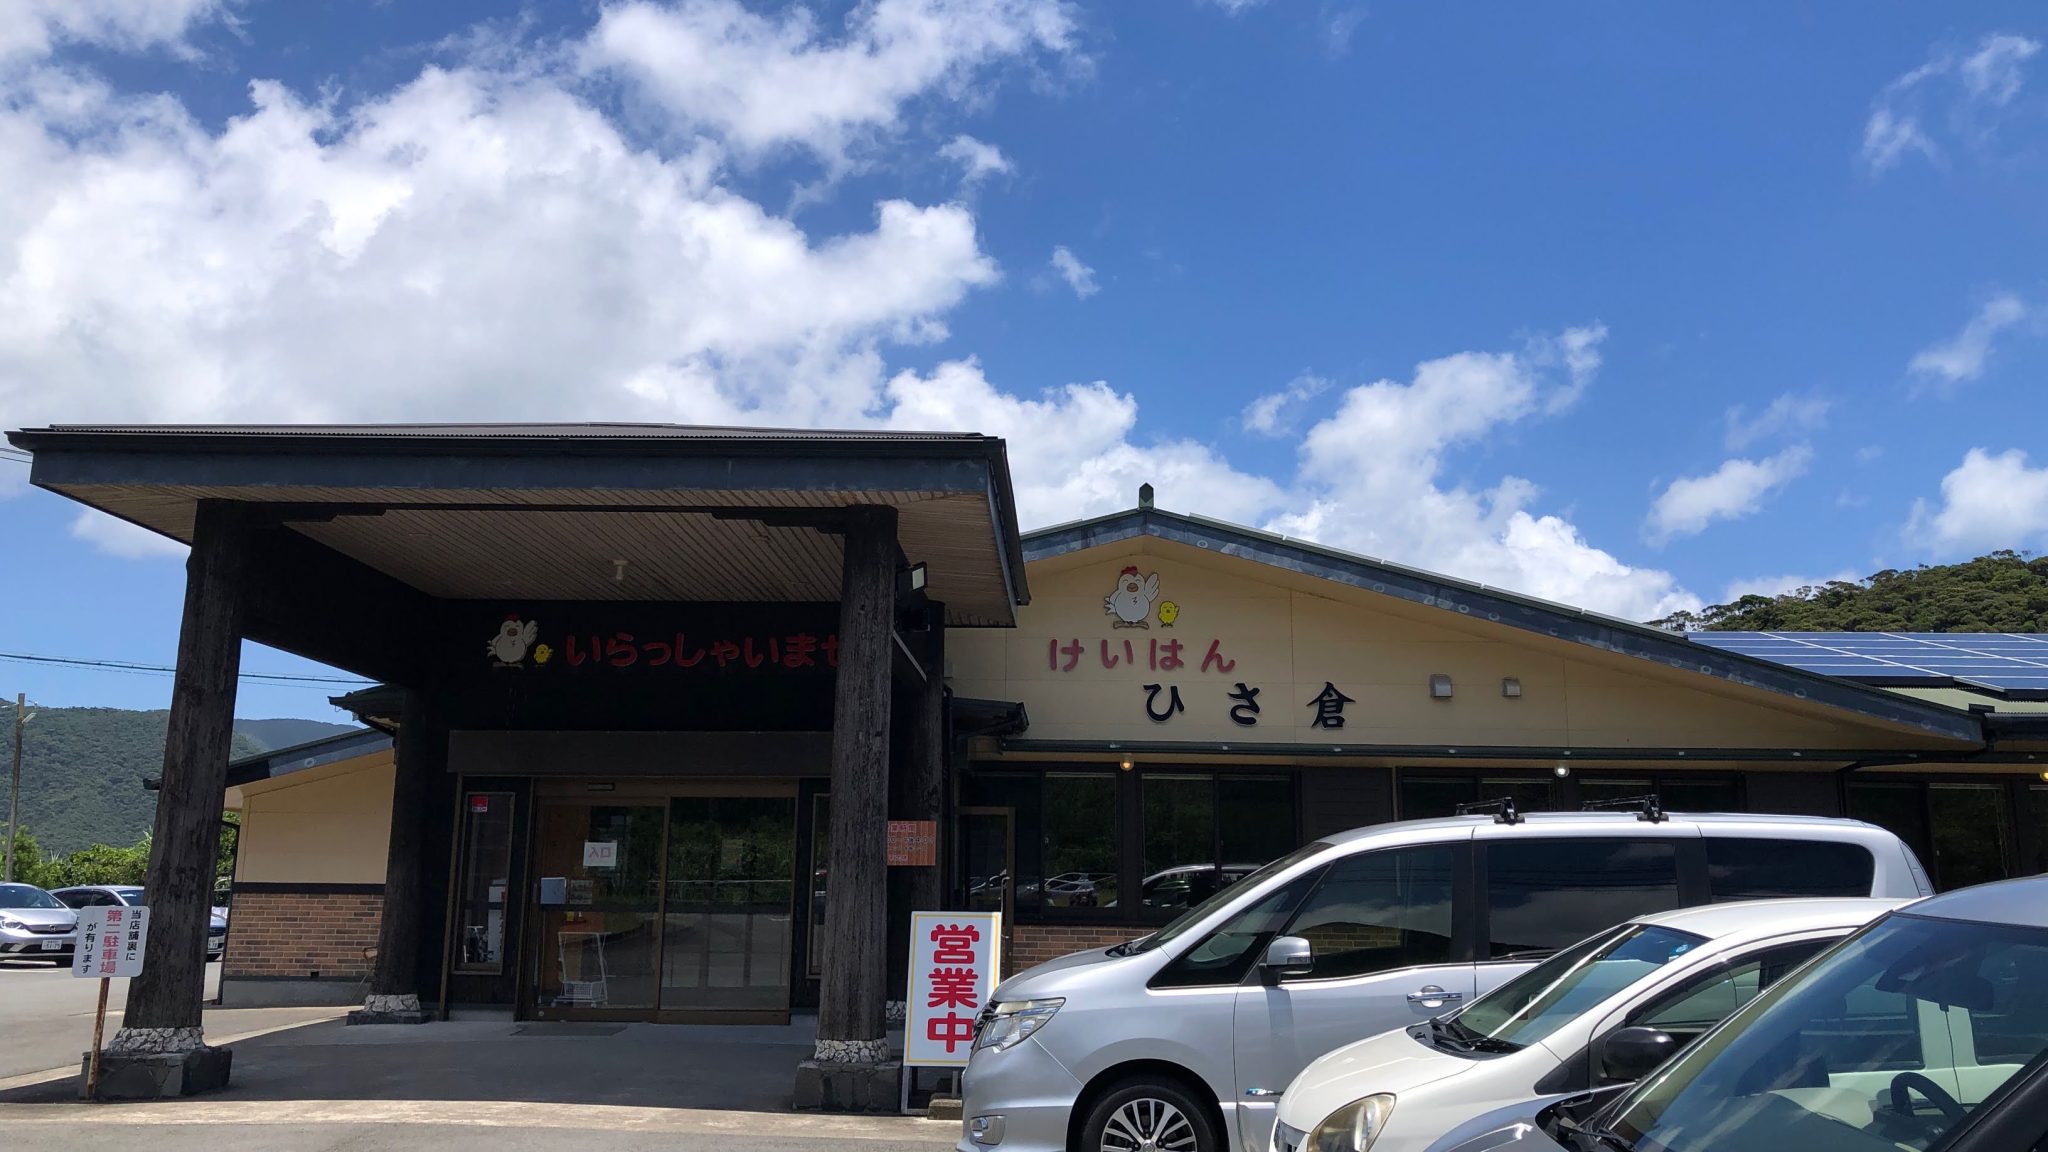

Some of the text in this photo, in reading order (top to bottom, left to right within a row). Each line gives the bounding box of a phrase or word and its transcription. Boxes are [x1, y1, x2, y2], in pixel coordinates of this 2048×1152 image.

[1049, 638, 1235, 672] けいはん
[1143, 681, 1355, 729] ひさ倉
[588, 846, 611, 858] 入口
[82, 921, 98, 974] が有ります
[99, 909, 123, 974] 第二駐車場
[126, 910, 142, 961] 当店舗裏に
[927, 924, 980, 1053] 営業中
